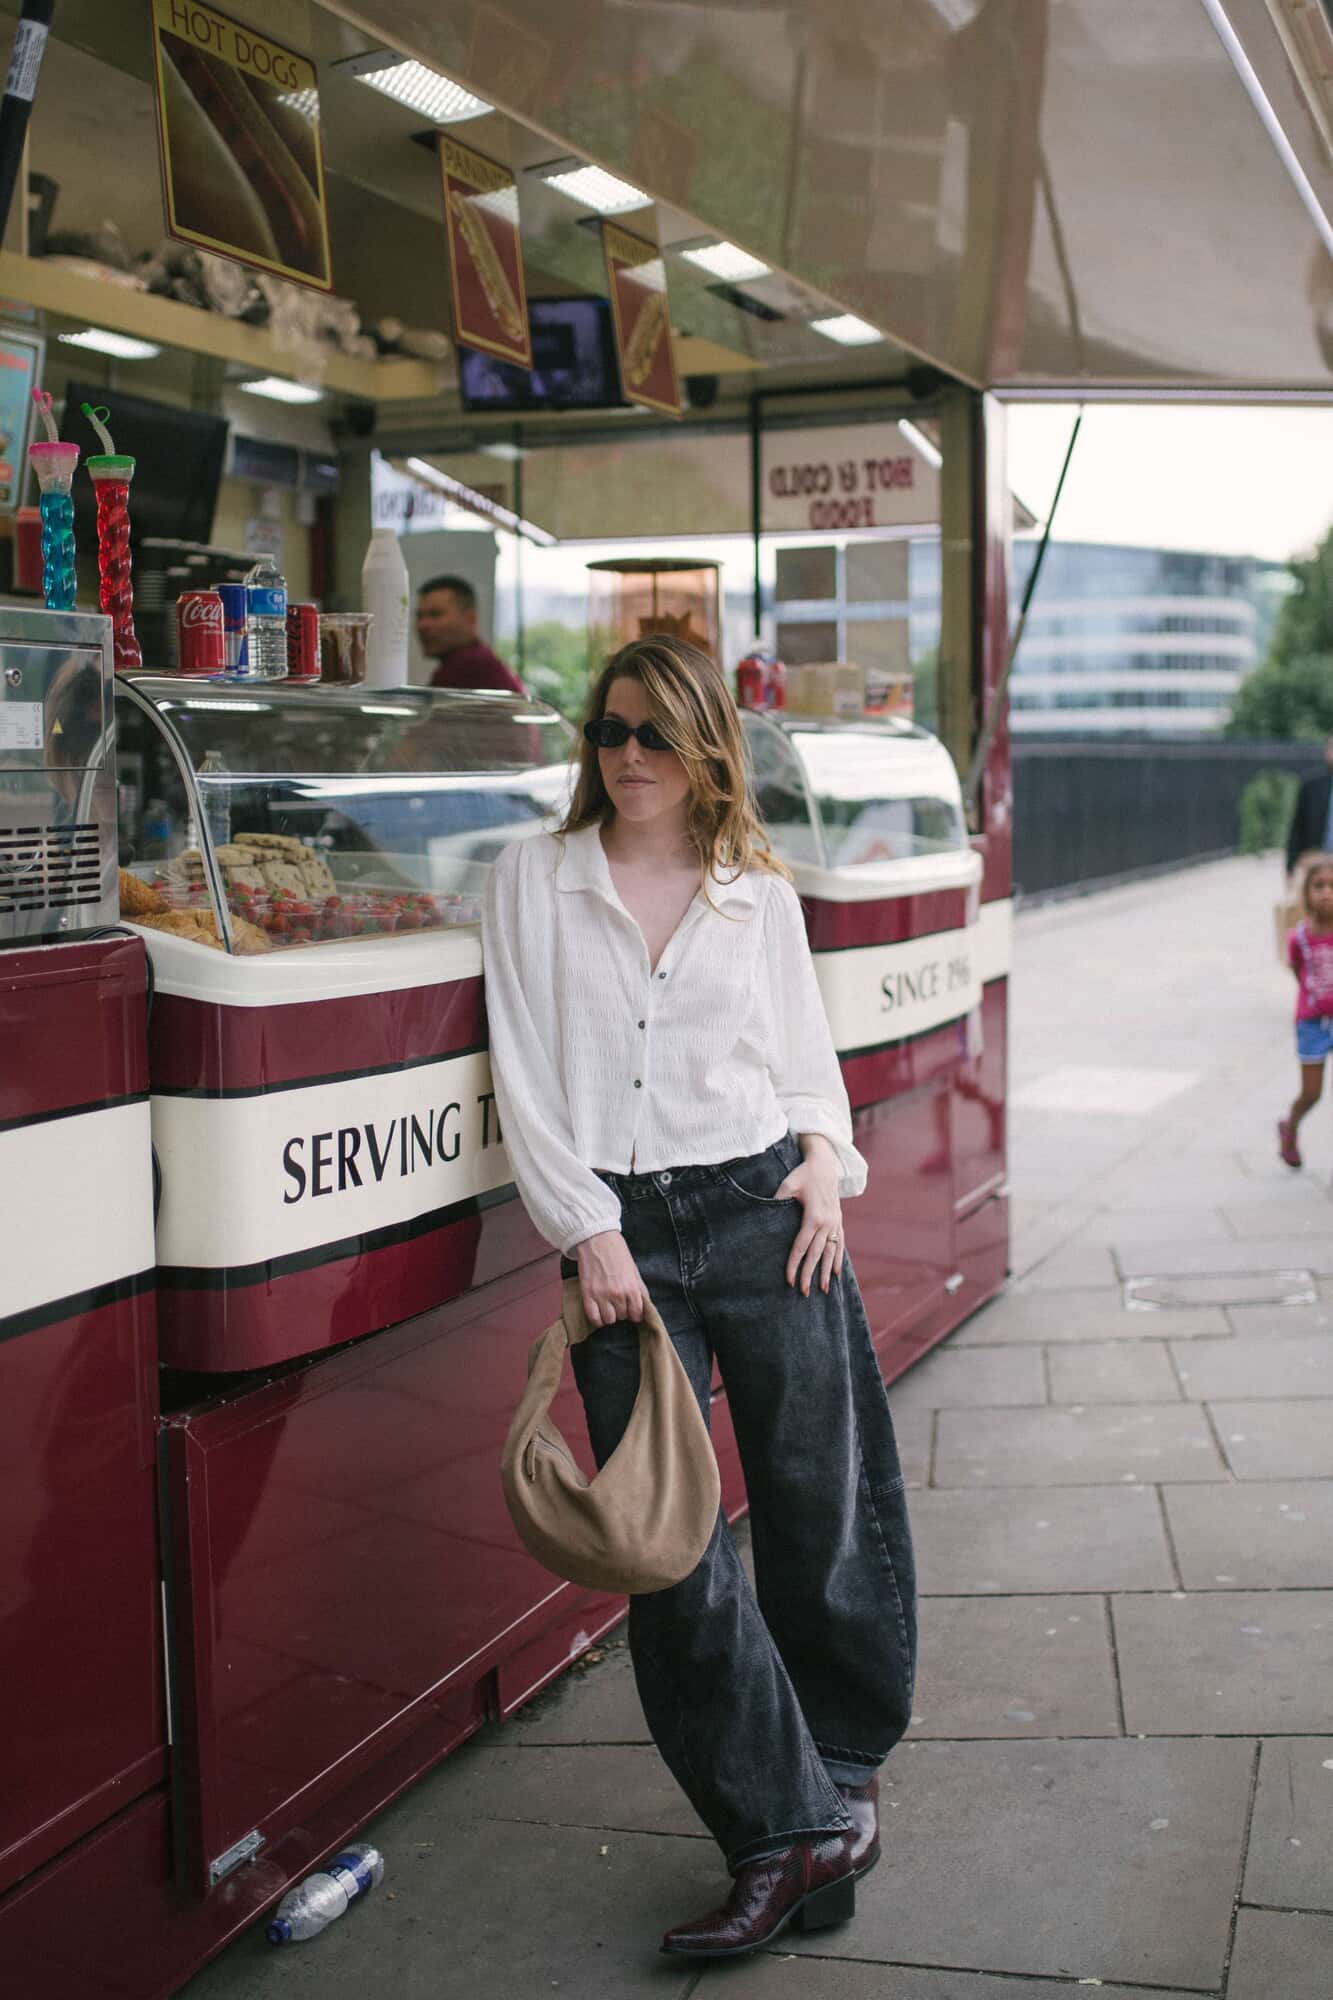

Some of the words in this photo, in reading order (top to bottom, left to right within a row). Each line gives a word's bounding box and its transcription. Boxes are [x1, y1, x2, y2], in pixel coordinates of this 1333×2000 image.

[170, 0, 225, 51] HOT
[234, 31, 298, 89] DOGS
[881, 961, 939, 1013] SINCE
[282, 1102, 461, 1204] SERVING
